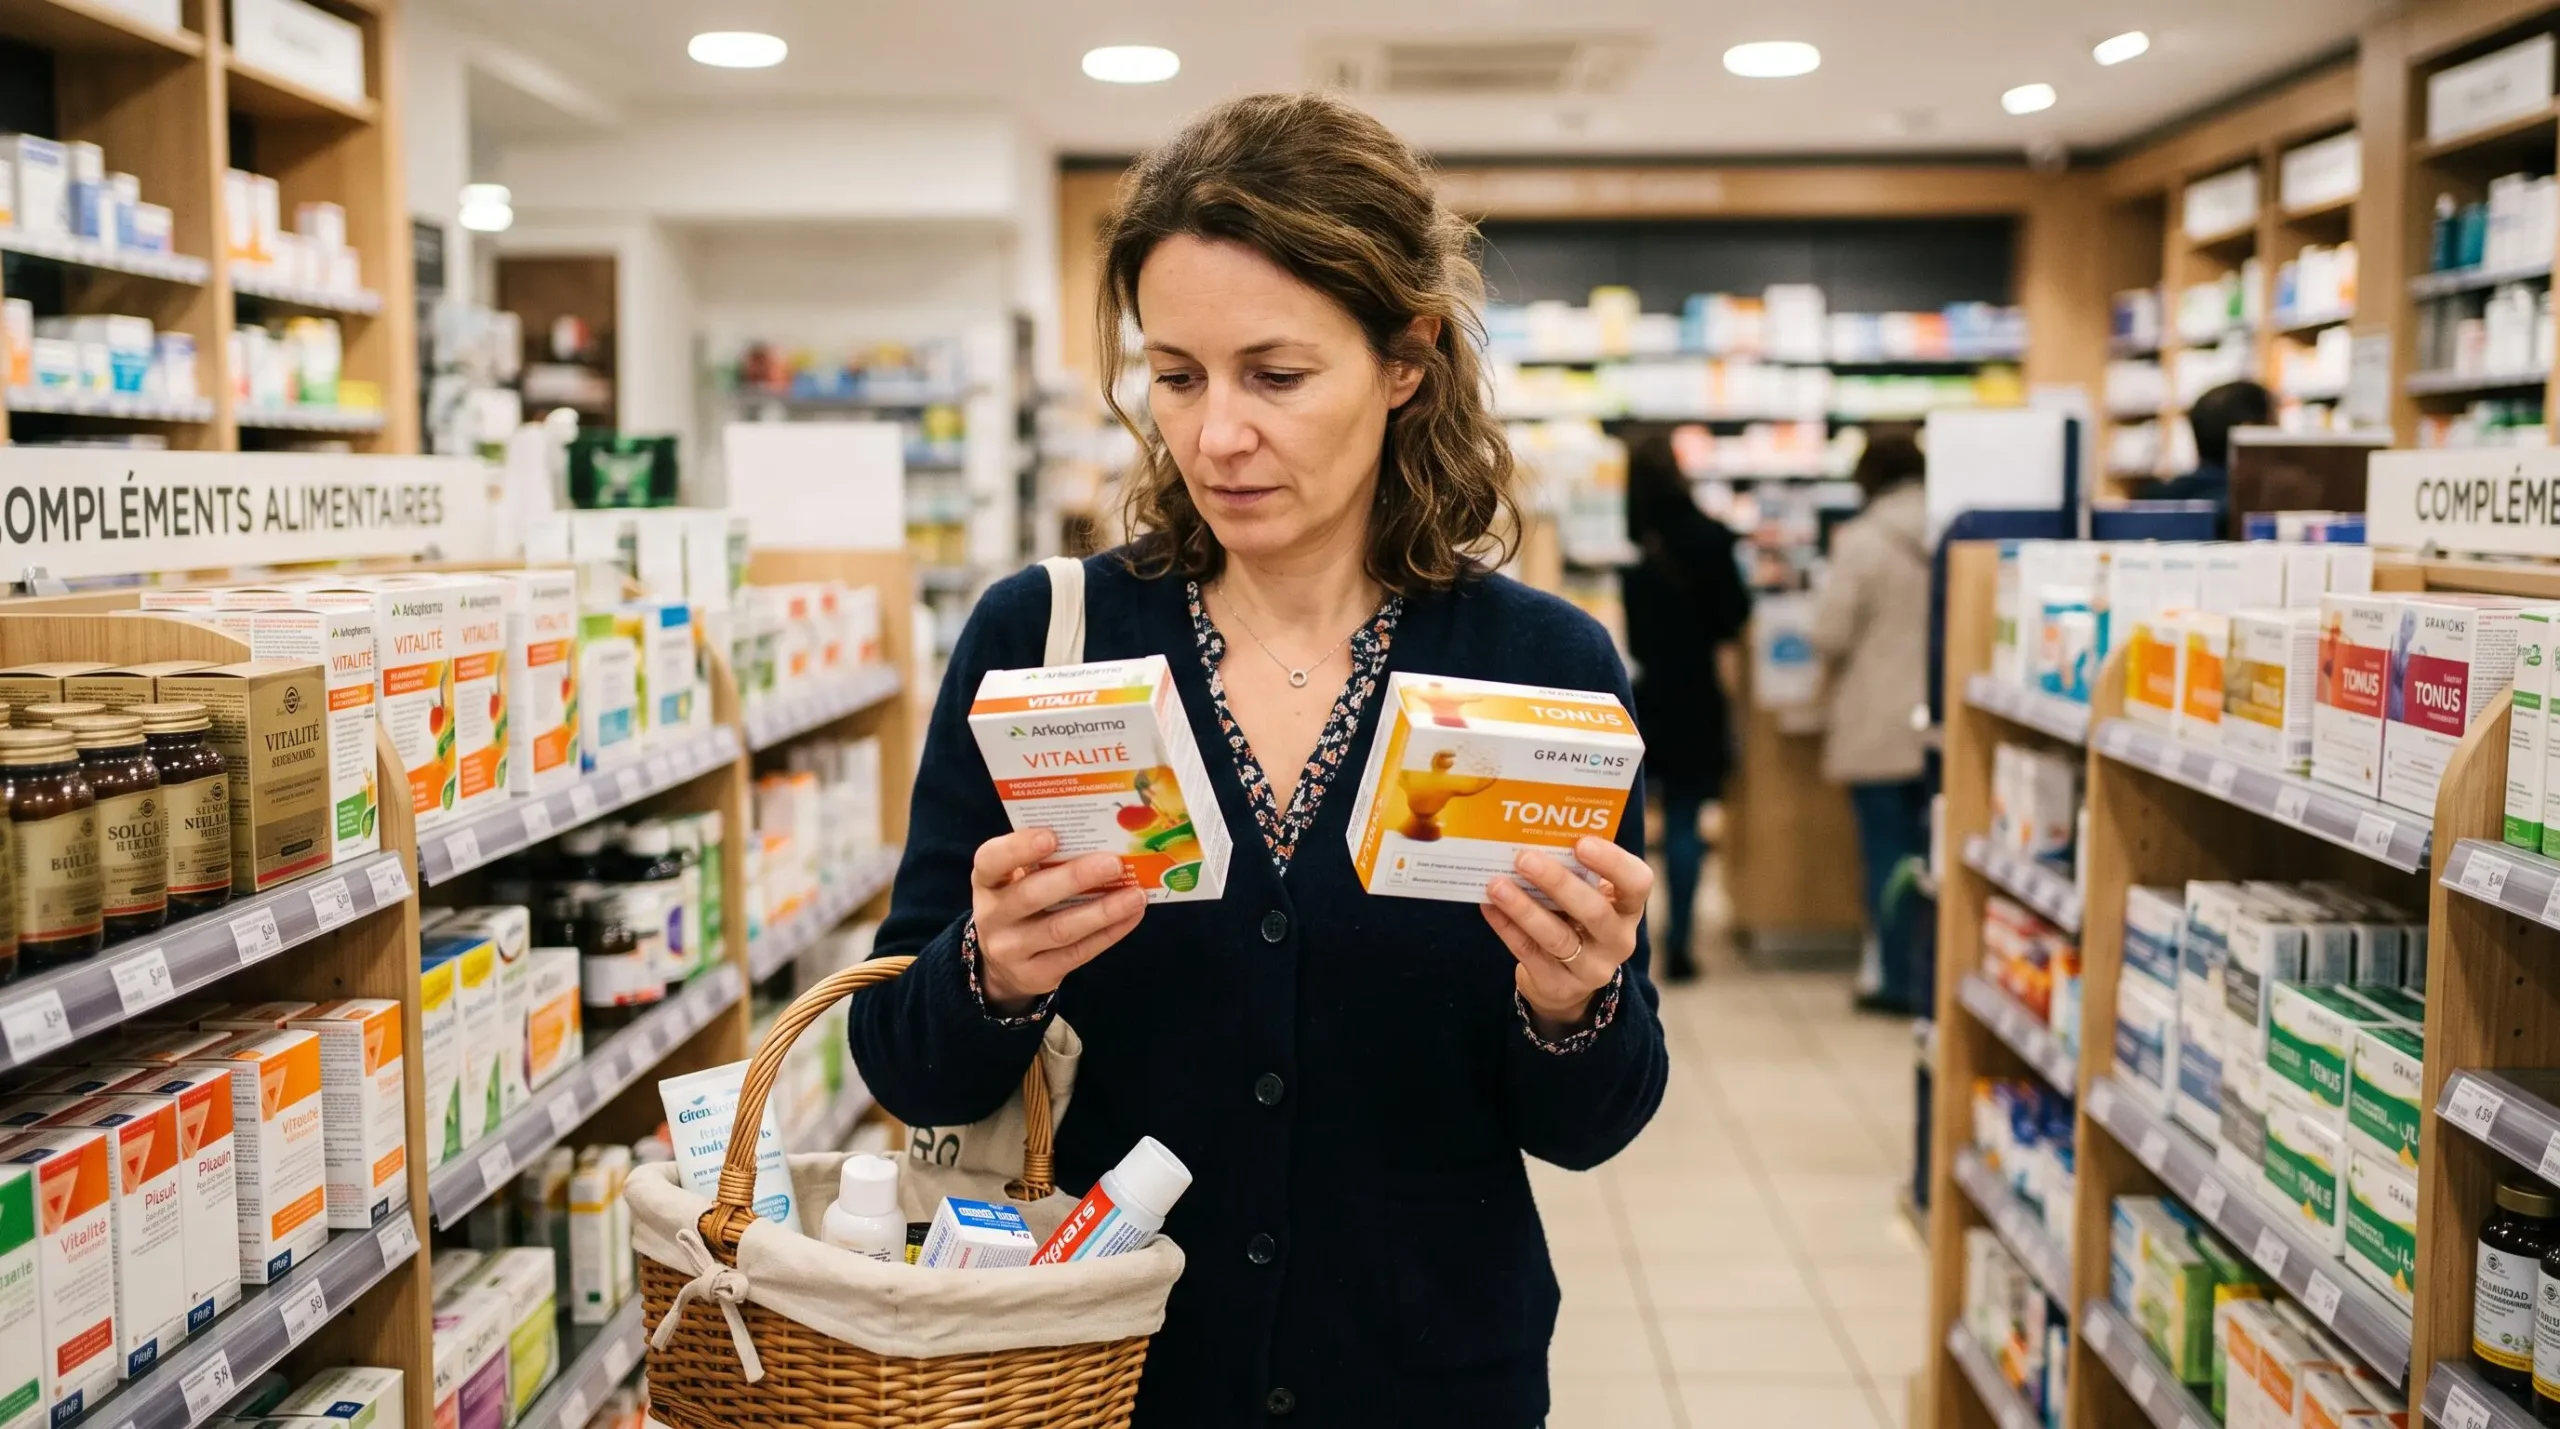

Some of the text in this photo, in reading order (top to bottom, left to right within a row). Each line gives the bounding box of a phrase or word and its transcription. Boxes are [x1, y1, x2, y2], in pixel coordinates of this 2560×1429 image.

[0, 470, 443, 544] OMPLÉMENTS ALIMENTAIRES
[2416, 462, 2560, 525] COMPLÉME
[394, 625, 443, 655] VITALITÉ
[332, 646, 372, 672] VITALITÉ
[2342, 667, 2380, 697] TONUS
[2414, 681, 2461, 713] TONUS
[1028, 690, 1099, 708] VITALITÉ
[1032, 719, 1126, 737] Arkopharma
[1529, 704, 1623, 727] TONUS
[265, 718, 320, 752] VITALITÉ
[1022, 742, 1130, 769] VITALITÉ
[1534, 749, 1625, 768] GRANIONS
[1502, 799, 1611, 831] TONUS
